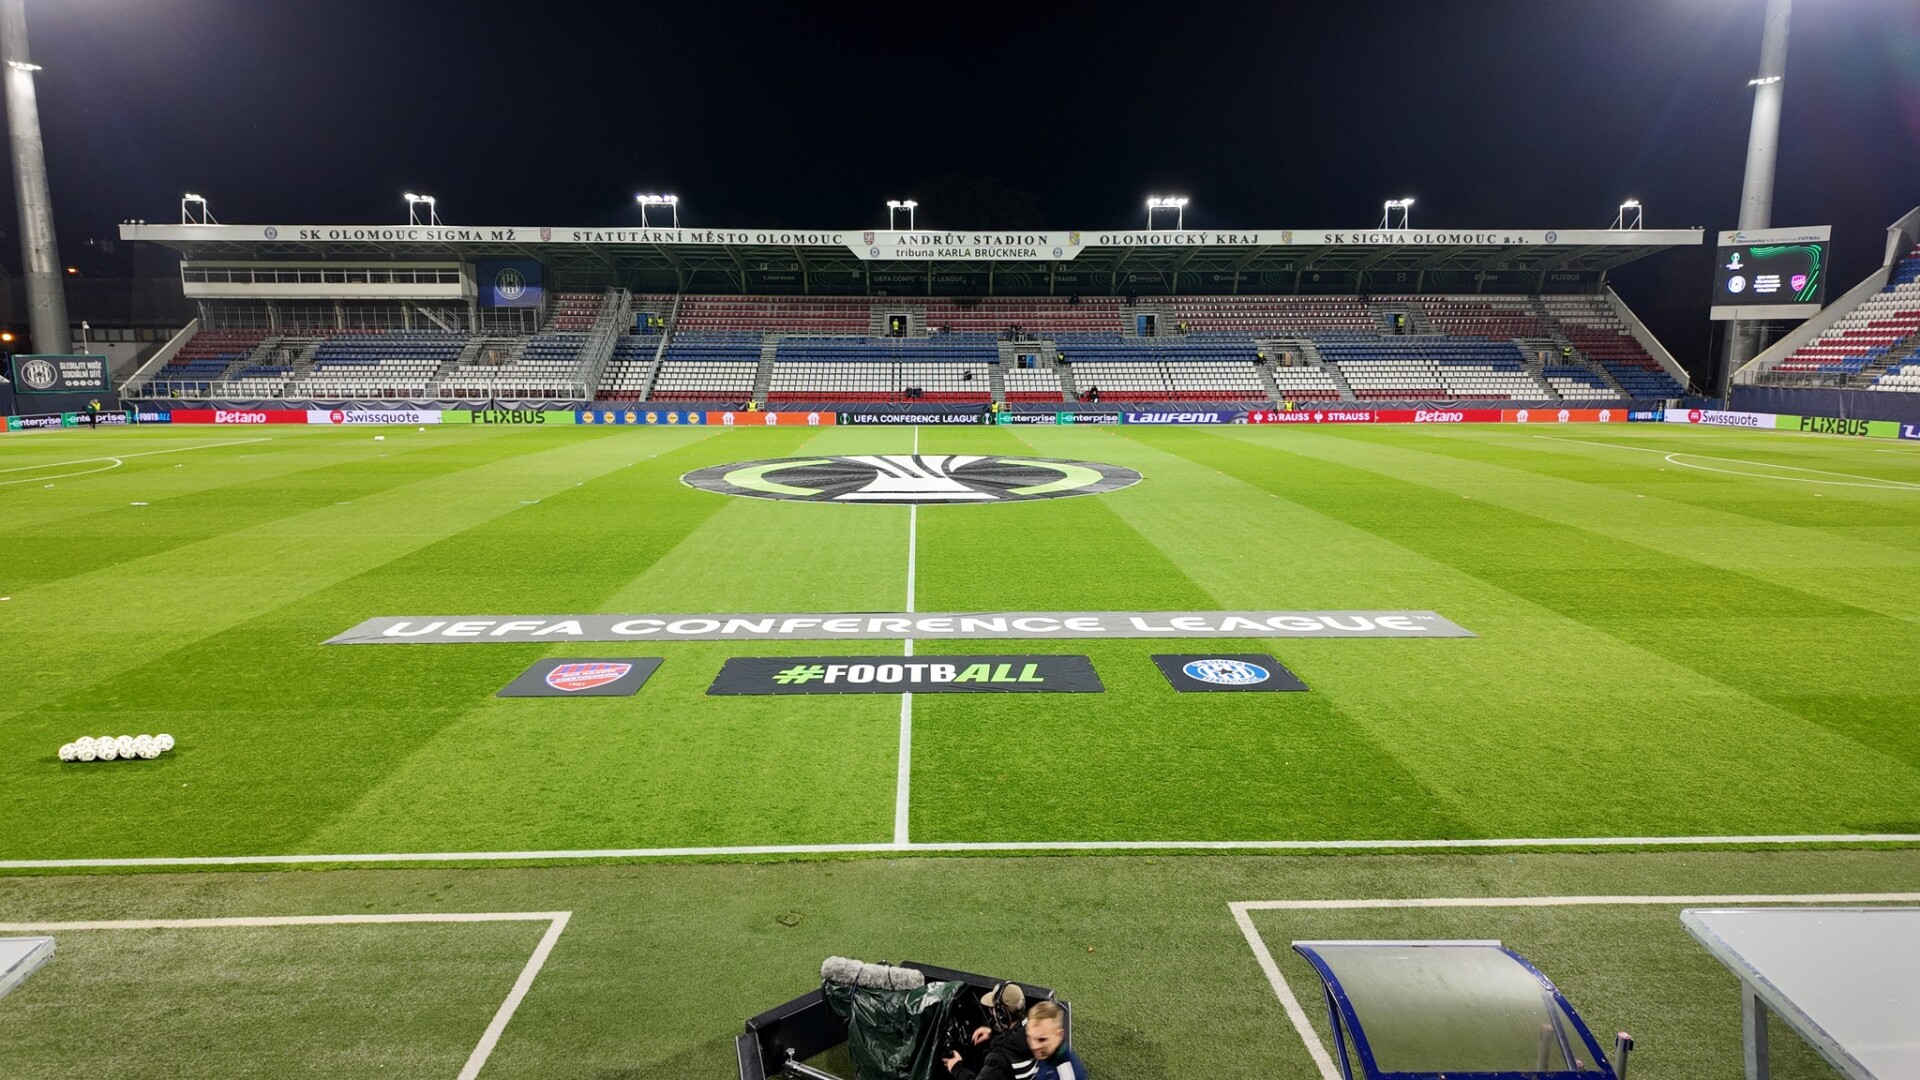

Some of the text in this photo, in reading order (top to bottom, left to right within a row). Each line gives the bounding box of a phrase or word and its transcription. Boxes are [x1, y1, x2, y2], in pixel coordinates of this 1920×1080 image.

[300, 228, 516, 240] SK OLOMOUC SIGMA MŽ
[573, 229, 843, 244] STATUTÁRNÍ MĚSTO OLOMOUC
[897, 232, 1048, 245] ANDRŮV STADION
[1099, 232, 1260, 244] OLOMOUCKÝ KRAJ
[1324, 234, 1529, 244] SK SIGMA OLOMOUC a.s.
[896, 246, 1037, 258] tribuna KARLA BRÜCKNERA
[12, 416, 62, 428] enterprise
[214, 410, 266, 424] Betano
[346, 410, 420, 424] Swissquote
[854, 414, 878, 423] UEFA
[880, 414, 940, 423] CONFERENCE
[1004, 413, 1056, 424] enterprise
[1066, 413, 1118, 424] enterprise
[1267, 412, 1310, 421] STRAUSS
[1328, 412, 1370, 420] STRAUSS
[1414, 410, 1463, 422] Betano
[1702, 410, 1758, 426] Swissquote
[382, 620, 584, 636] UEFA
[611, 616, 1106, 636] CONFERENCE
[772, 663, 1044, 685] #FOOTBALL
